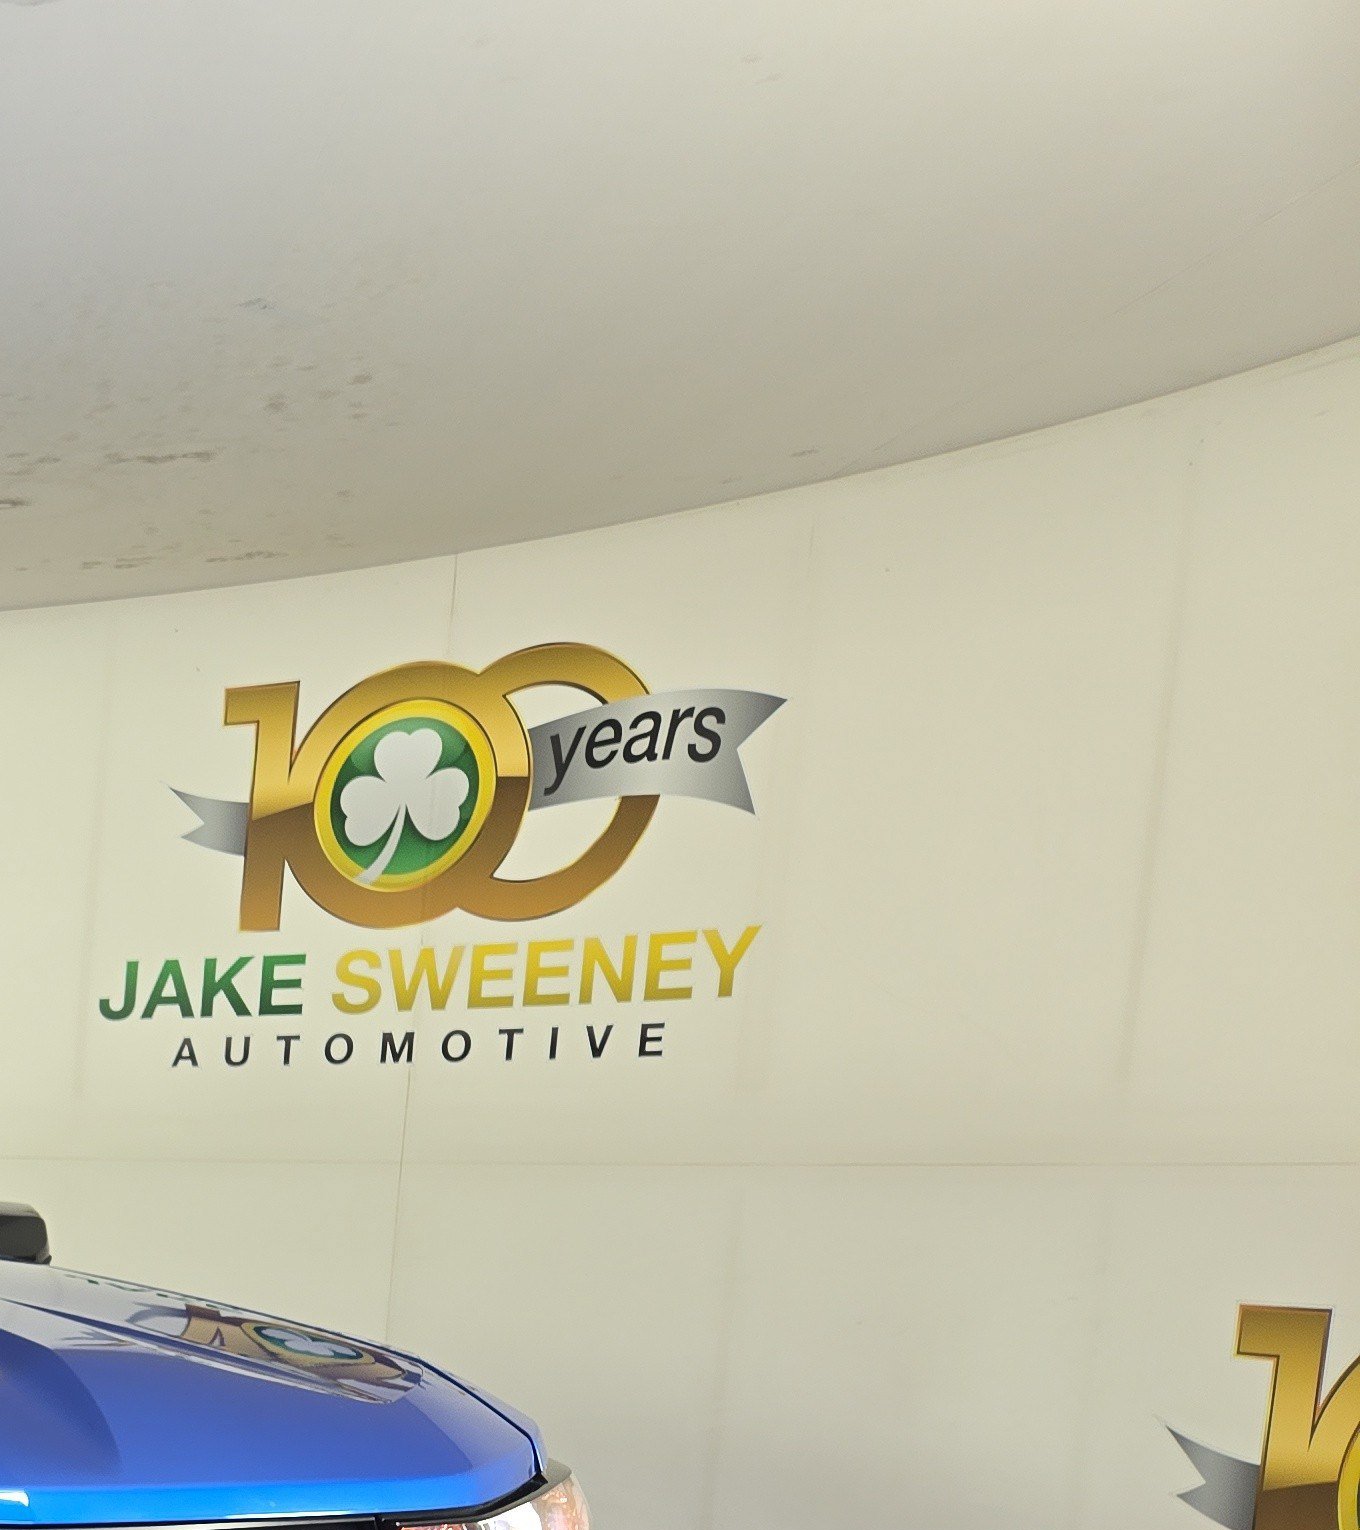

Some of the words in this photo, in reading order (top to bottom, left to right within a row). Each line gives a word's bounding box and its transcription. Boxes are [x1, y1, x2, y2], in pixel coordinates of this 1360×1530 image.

[223, 641, 661, 932] 100
[543, 704, 726, 797] years
[98, 953, 307, 1022] JAKE
[331, 925, 764, 1017] SWEENEY
[171, 1022, 668, 1069] AUTOMOTIVE
